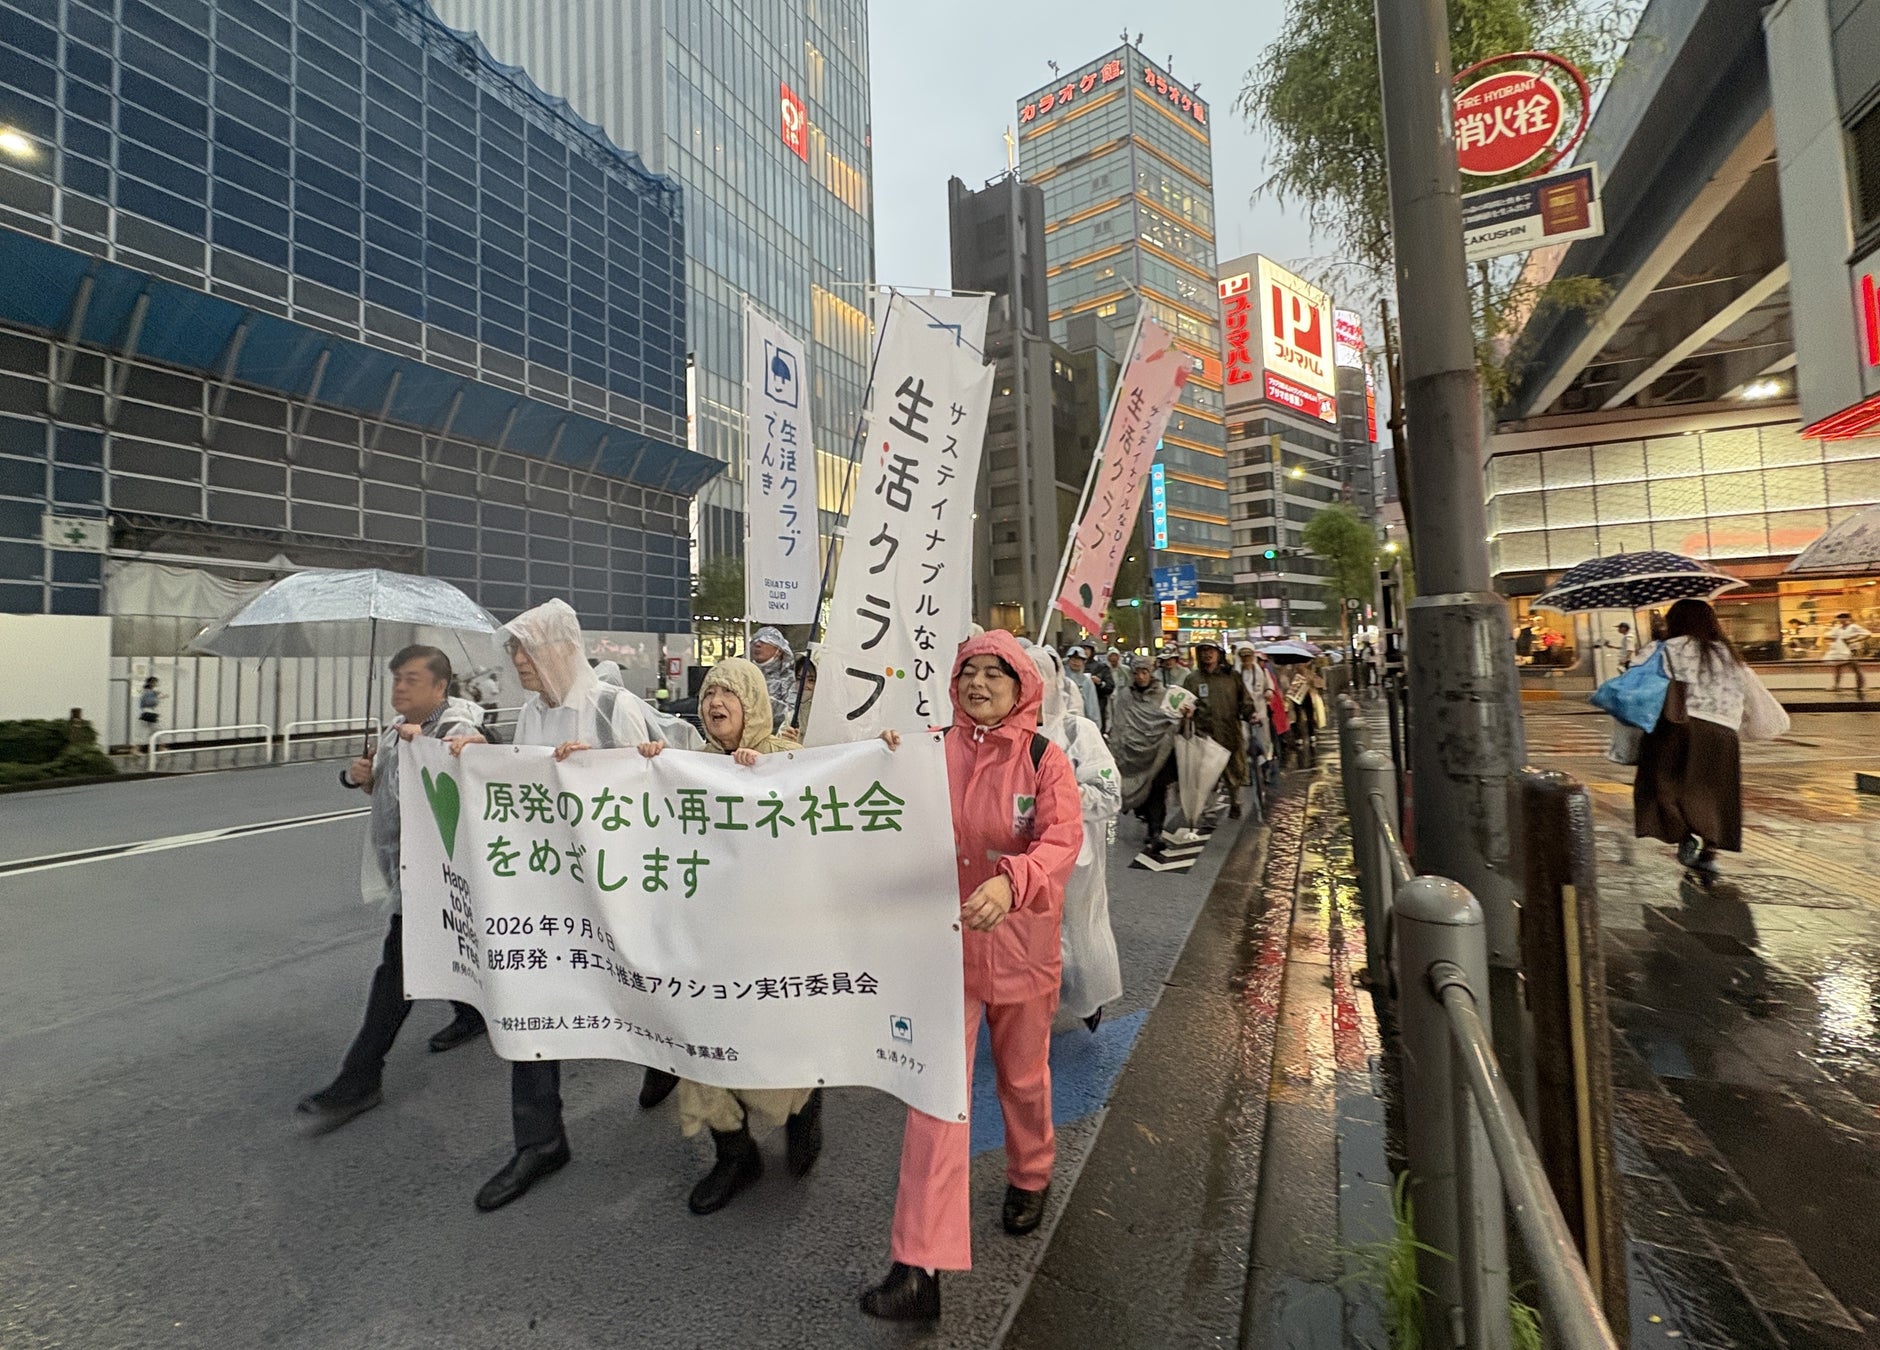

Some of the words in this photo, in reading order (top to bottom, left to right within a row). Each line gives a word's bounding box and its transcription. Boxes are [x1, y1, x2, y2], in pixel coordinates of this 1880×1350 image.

[1454, 94, 1552, 151] 消火栓
[1457, 94, 1481, 110] FIRE
[1484, 79, 1535, 103] HYDRANT
[1222, 294, 1253, 385] プリマハム
[1274, 341, 1324, 378] プリマハム
[761, 411, 777, 496] でんき
[778, 419, 801, 557] 生活クラブ
[846, 375, 935, 720] 生活クラブ
[483, 780, 905, 838] 原発のない再エネ社会
[486, 834, 711, 899] をめざします
[450, 889, 462, 913] to
[488, 948, 879, 1000] 脱原発・再エネ推進アクション実行委員会
[876, 1048, 926, 1074] 生活クラブ
